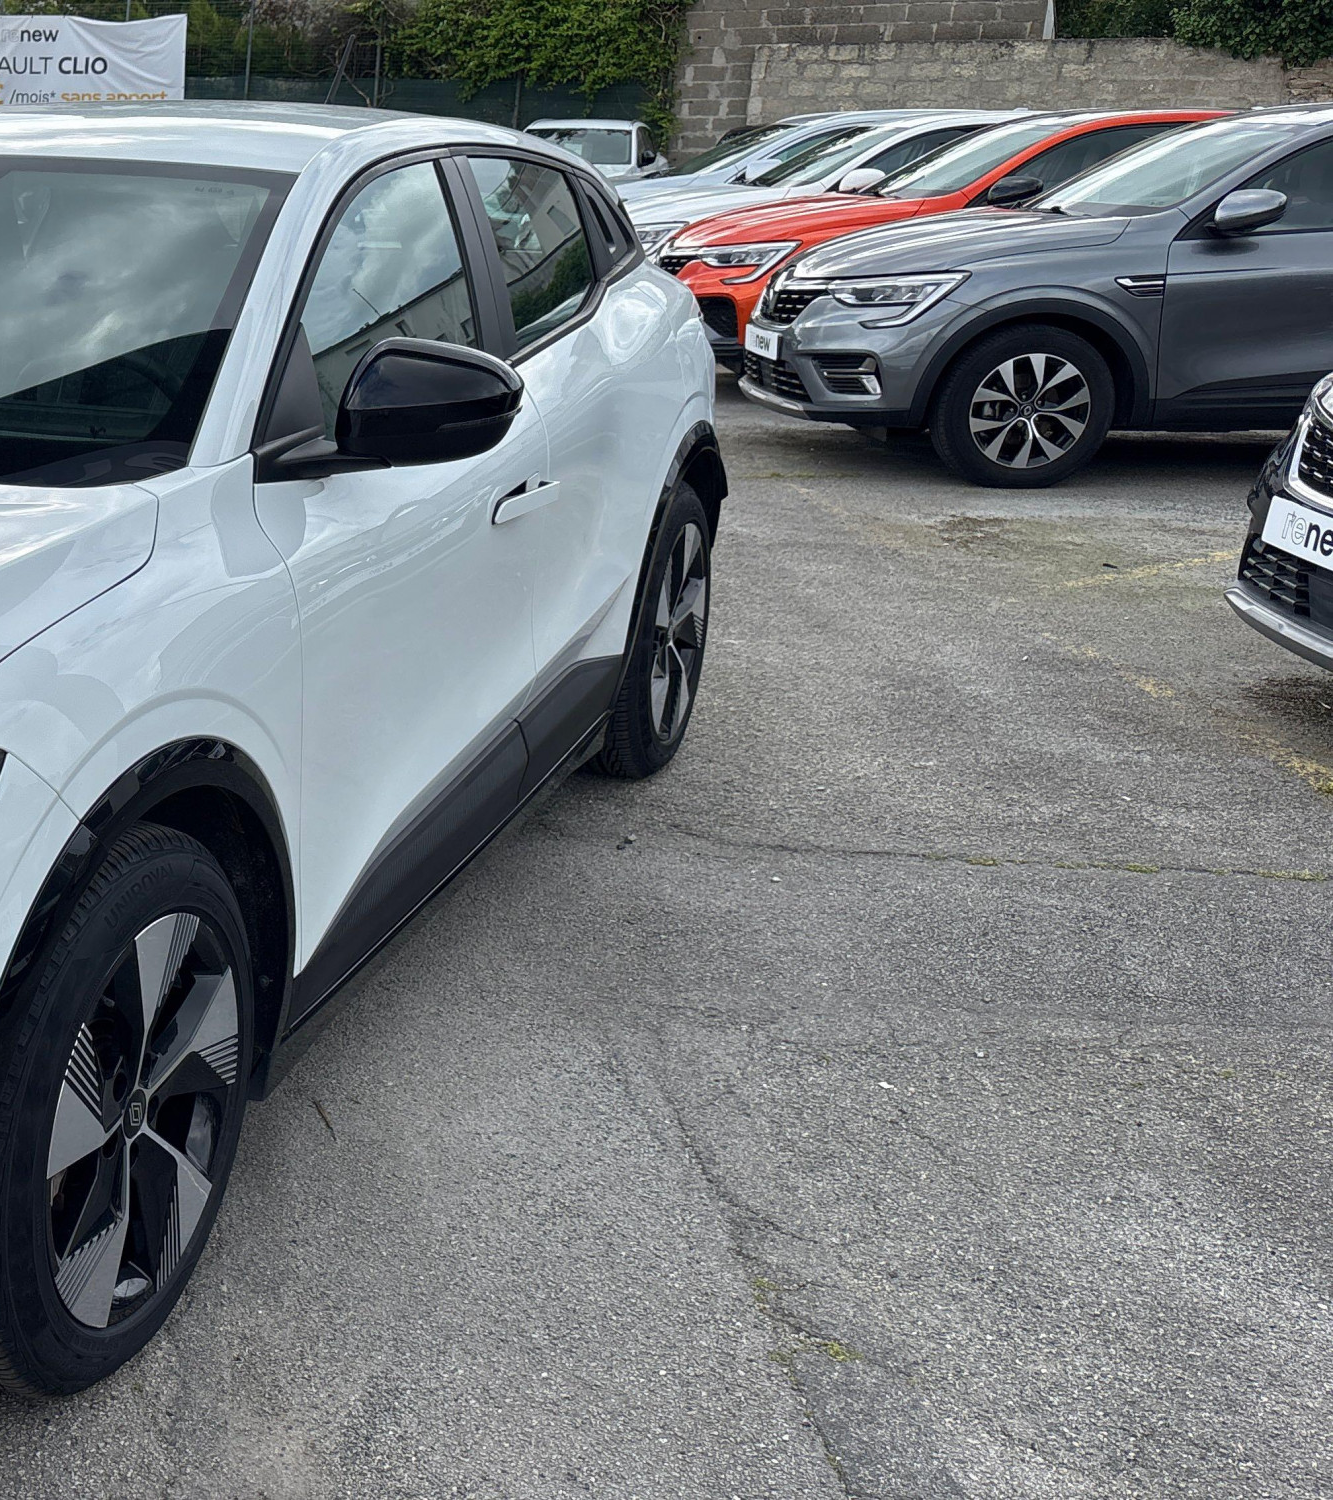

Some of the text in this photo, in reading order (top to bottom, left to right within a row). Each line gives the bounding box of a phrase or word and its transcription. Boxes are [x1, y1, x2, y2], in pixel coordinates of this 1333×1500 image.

[1, 28, 59, 43] renew
[58, 56, 108, 75] CLIO
[1281, 512, 1333, 557] rene
